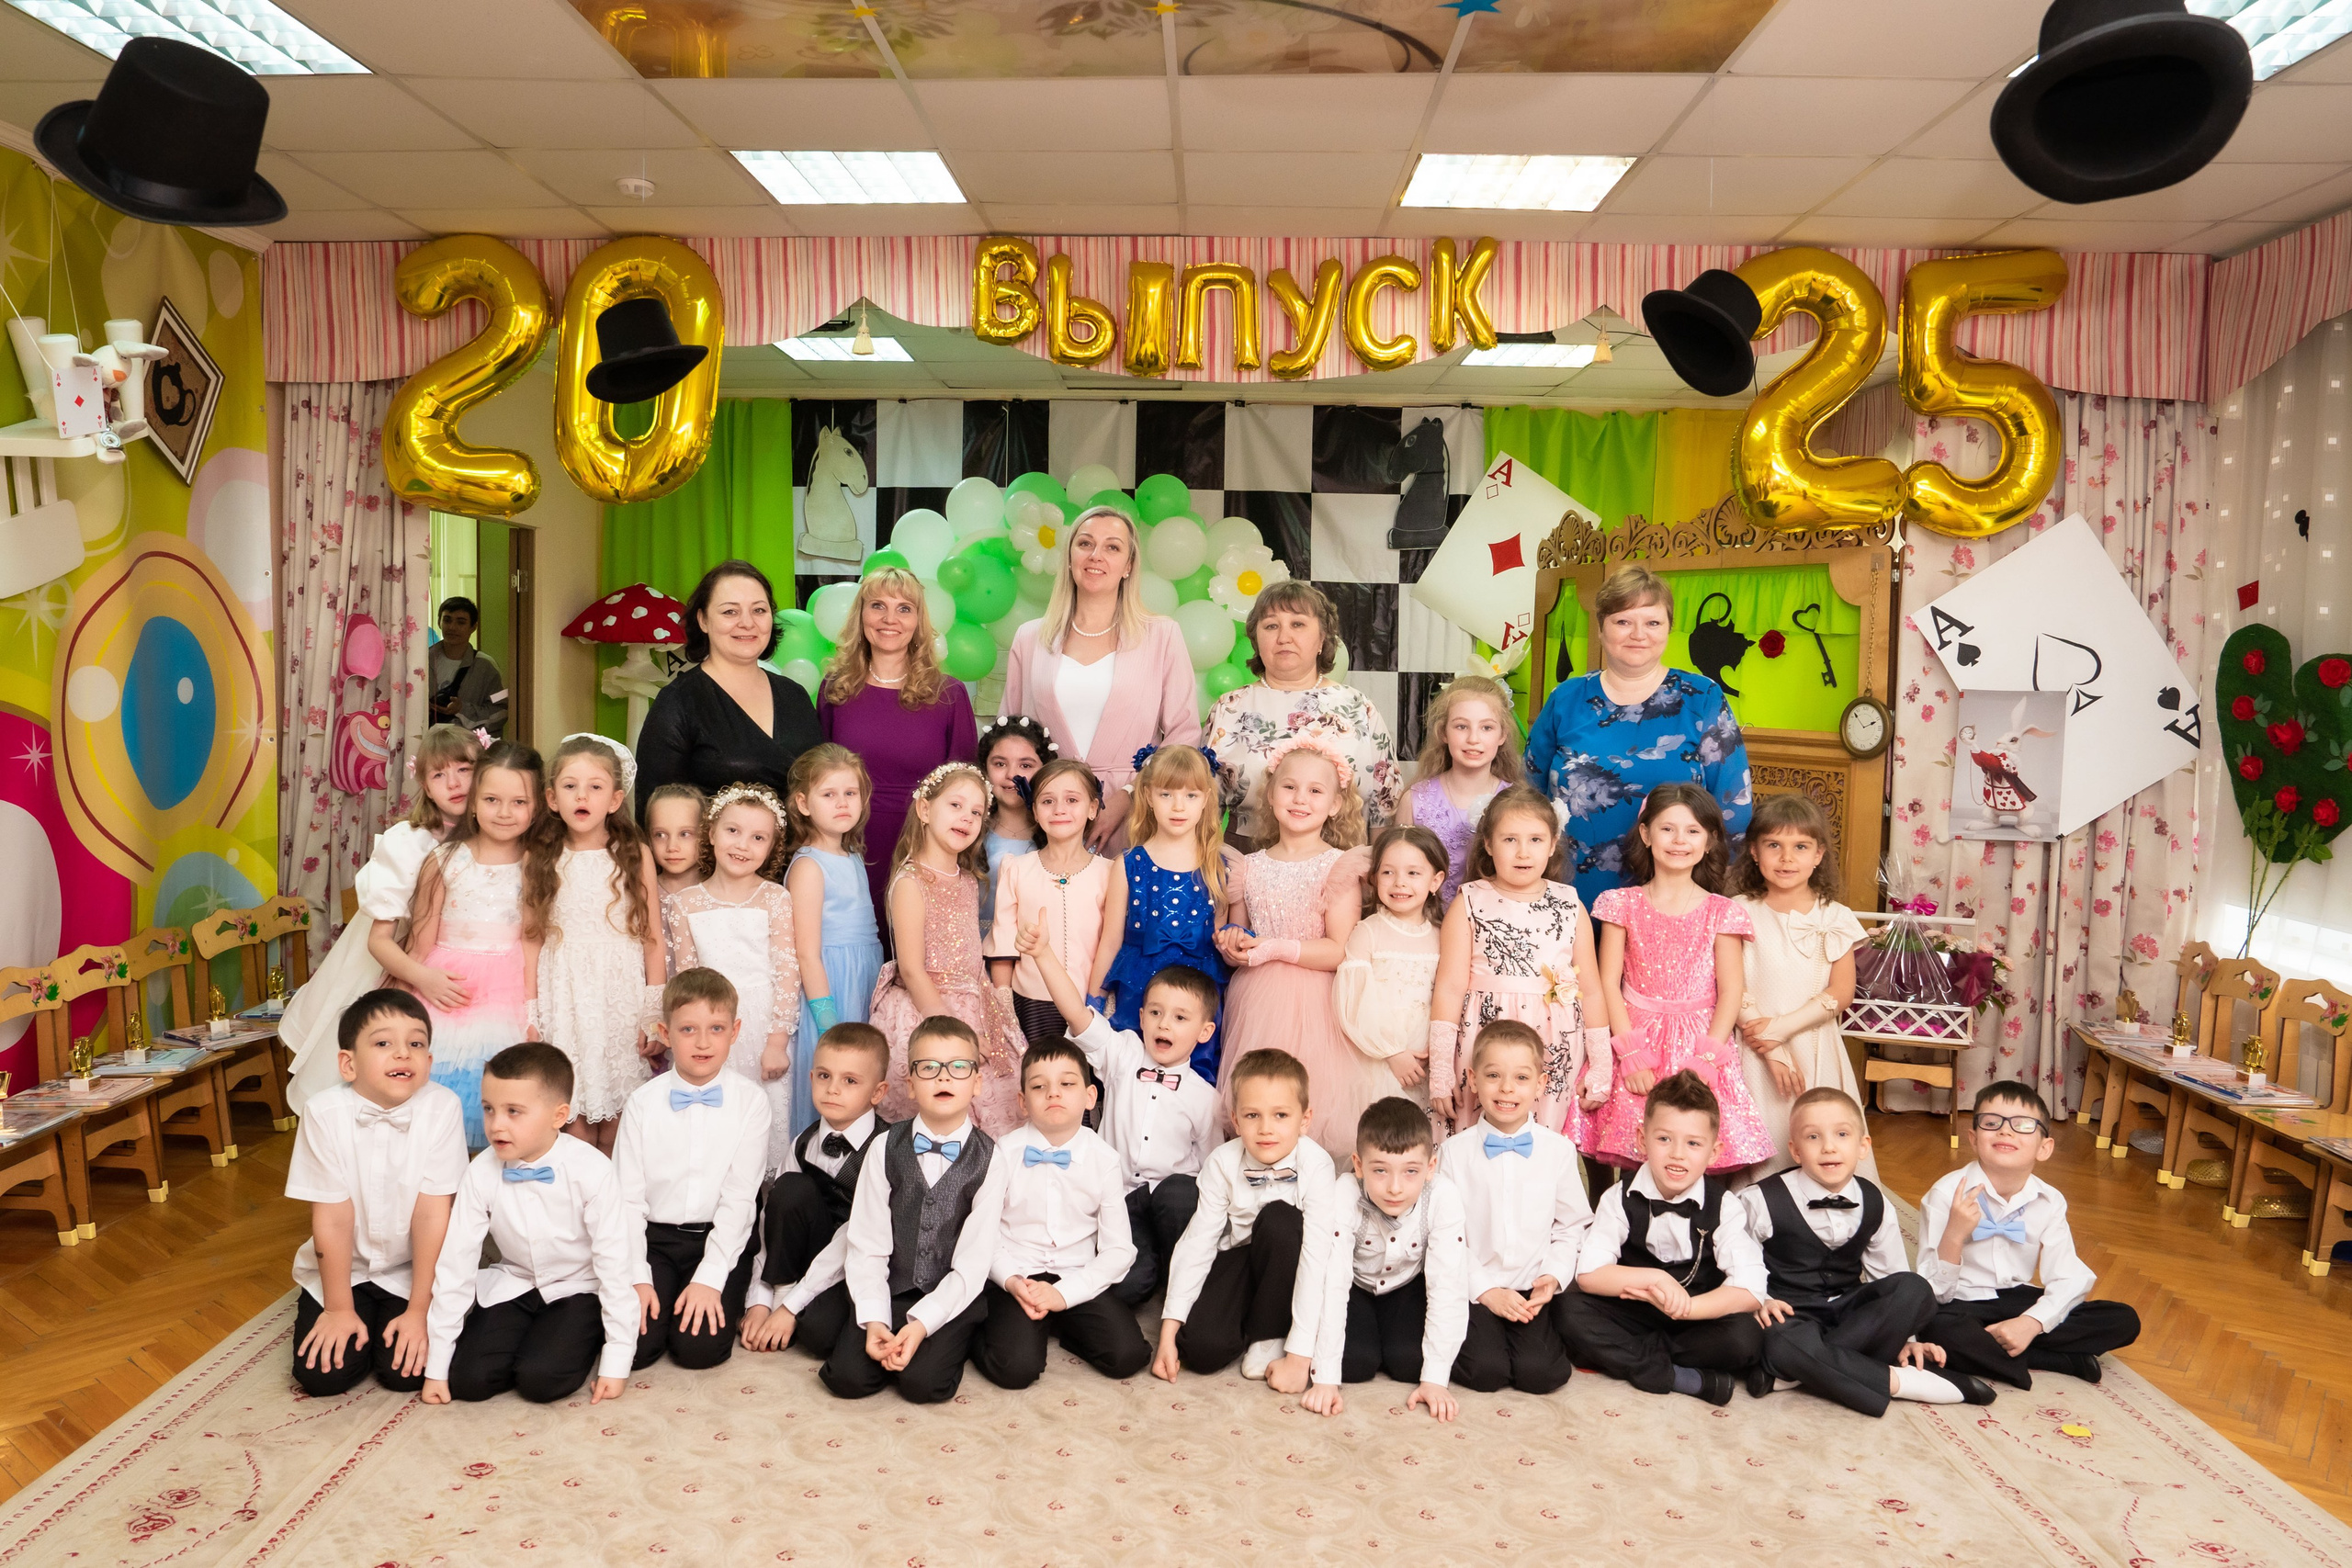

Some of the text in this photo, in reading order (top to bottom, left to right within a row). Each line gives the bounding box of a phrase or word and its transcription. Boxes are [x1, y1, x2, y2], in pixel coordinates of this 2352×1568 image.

[971, 236, 1498, 379] ВЫПУСК
[381, 232, 725, 520] 20
[1730, 246, 2069, 540] 25
[1487, 457, 1513, 488] A
[1930, 605, 1975, 651] A
[666, 649, 687, 678] A
[2162, 703, 2201, 750] A
